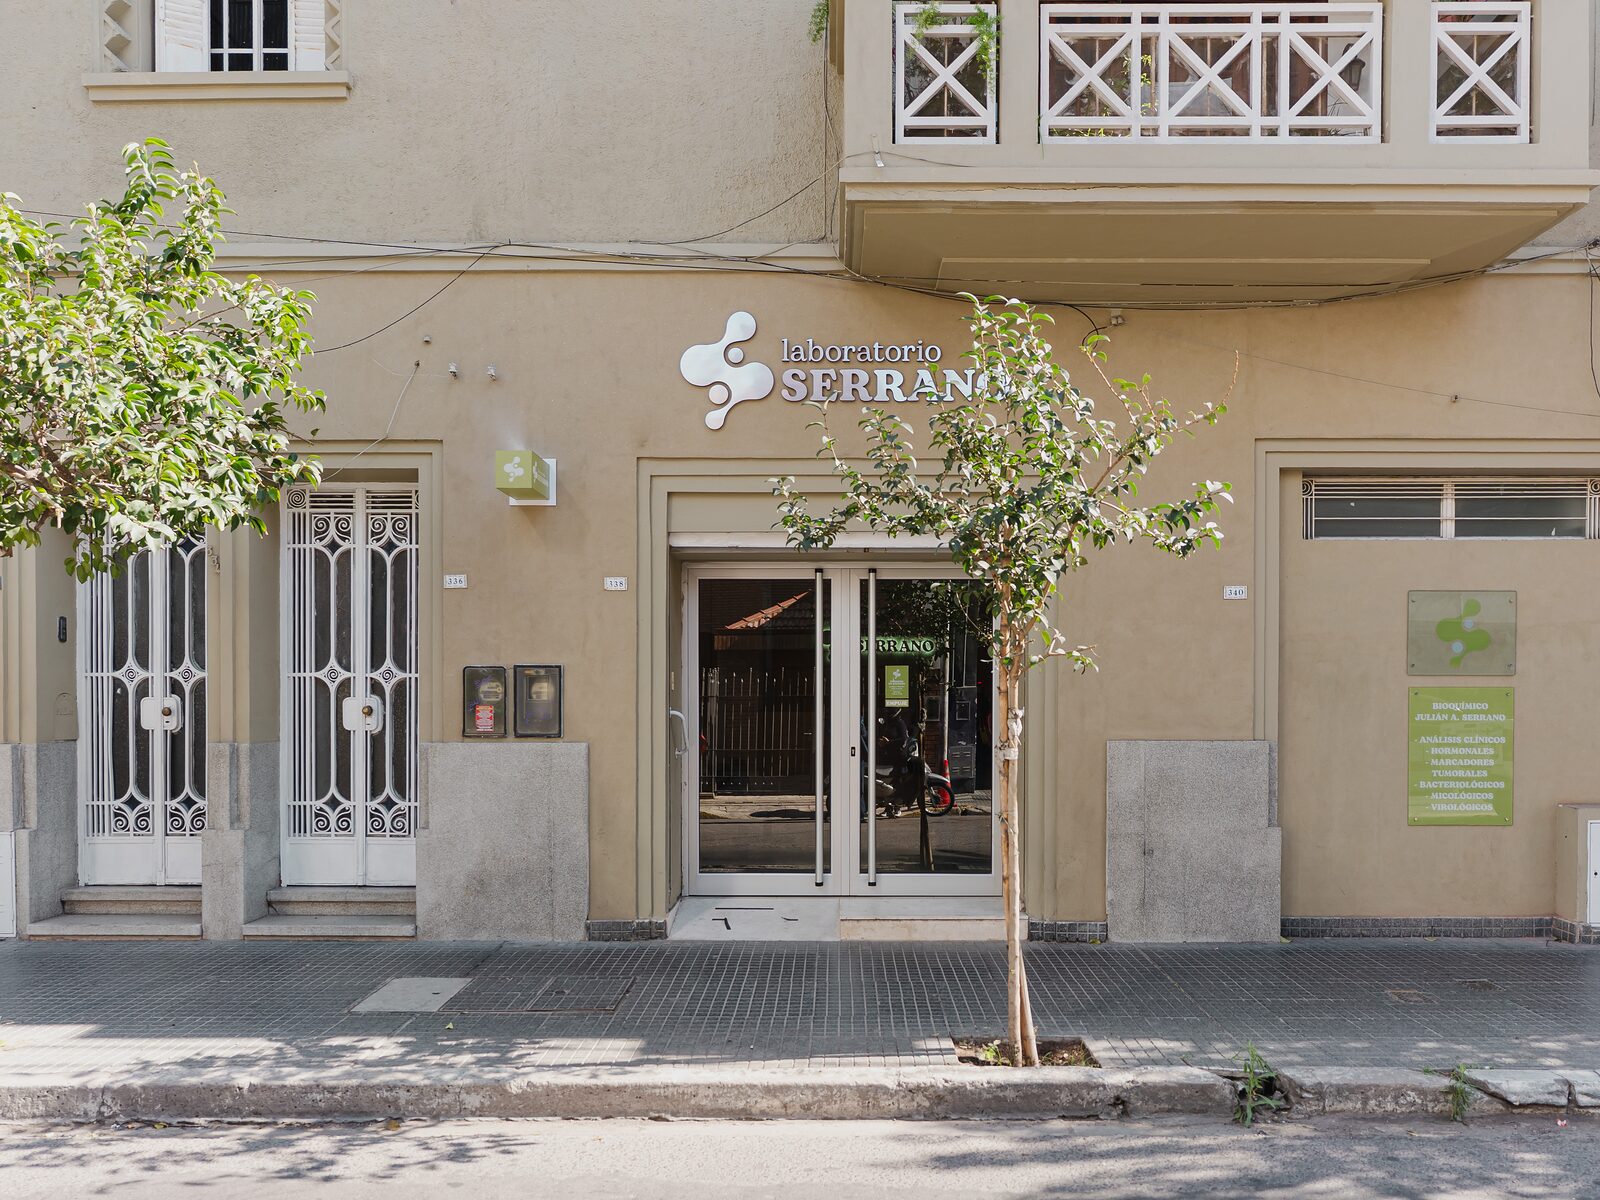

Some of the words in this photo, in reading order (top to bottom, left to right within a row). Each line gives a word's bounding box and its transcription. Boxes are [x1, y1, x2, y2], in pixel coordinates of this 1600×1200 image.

[781, 338, 942, 363] laboratorio
[448, 577, 463, 585] 336
[609, 580, 624, 588] 338
[1432, 701, 1489, 711] BIOQUÍMICO
[1415, 712, 1449, 721] JULIÁN
[1450, 713, 1460, 721] A.
[1461, 713, 1506, 721] SERRANO
[1419, 734, 1462, 744] ANÁLISIS
[1463, 734, 1506, 744] CLÍNICOS
[1431, 747, 1495, 755] HORMONALES
[1430, 758, 1495, 766] MARCADORES
[1432, 769, 1488, 777] TUMORALES
[1419, 780, 1505, 789] BACTERIOLÓGICOS
[1430, 791, 1494, 800] MICOLÓGICOS
[1430, 802, 1494, 811] VIROLÓGICOS
